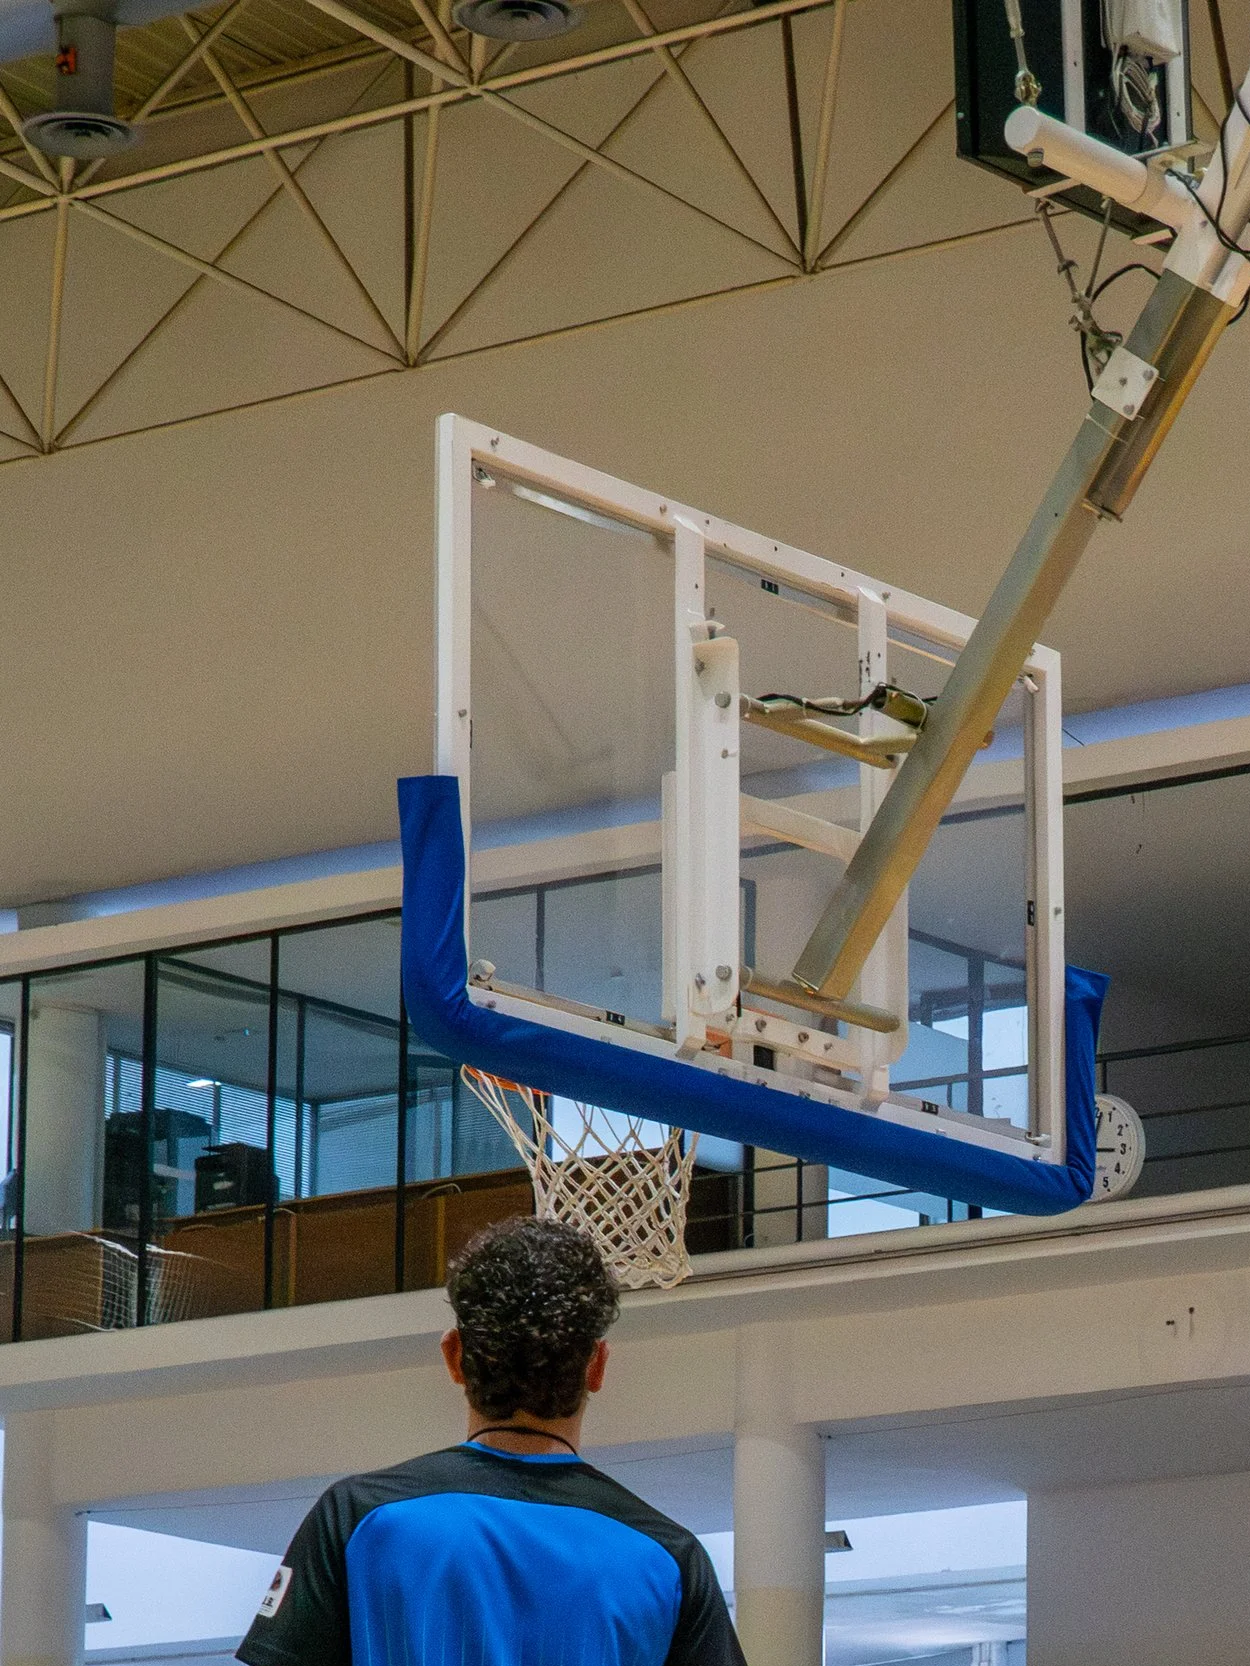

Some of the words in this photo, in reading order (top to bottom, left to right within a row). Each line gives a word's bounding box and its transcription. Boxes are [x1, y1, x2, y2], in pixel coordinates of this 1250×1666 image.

[1117, 1124, 1123, 1136] 2
[1120, 1143, 1127, 1155] 3
[1114, 1162, 1121, 1174] 4
[1102, 1176, 1109, 1188] 5
